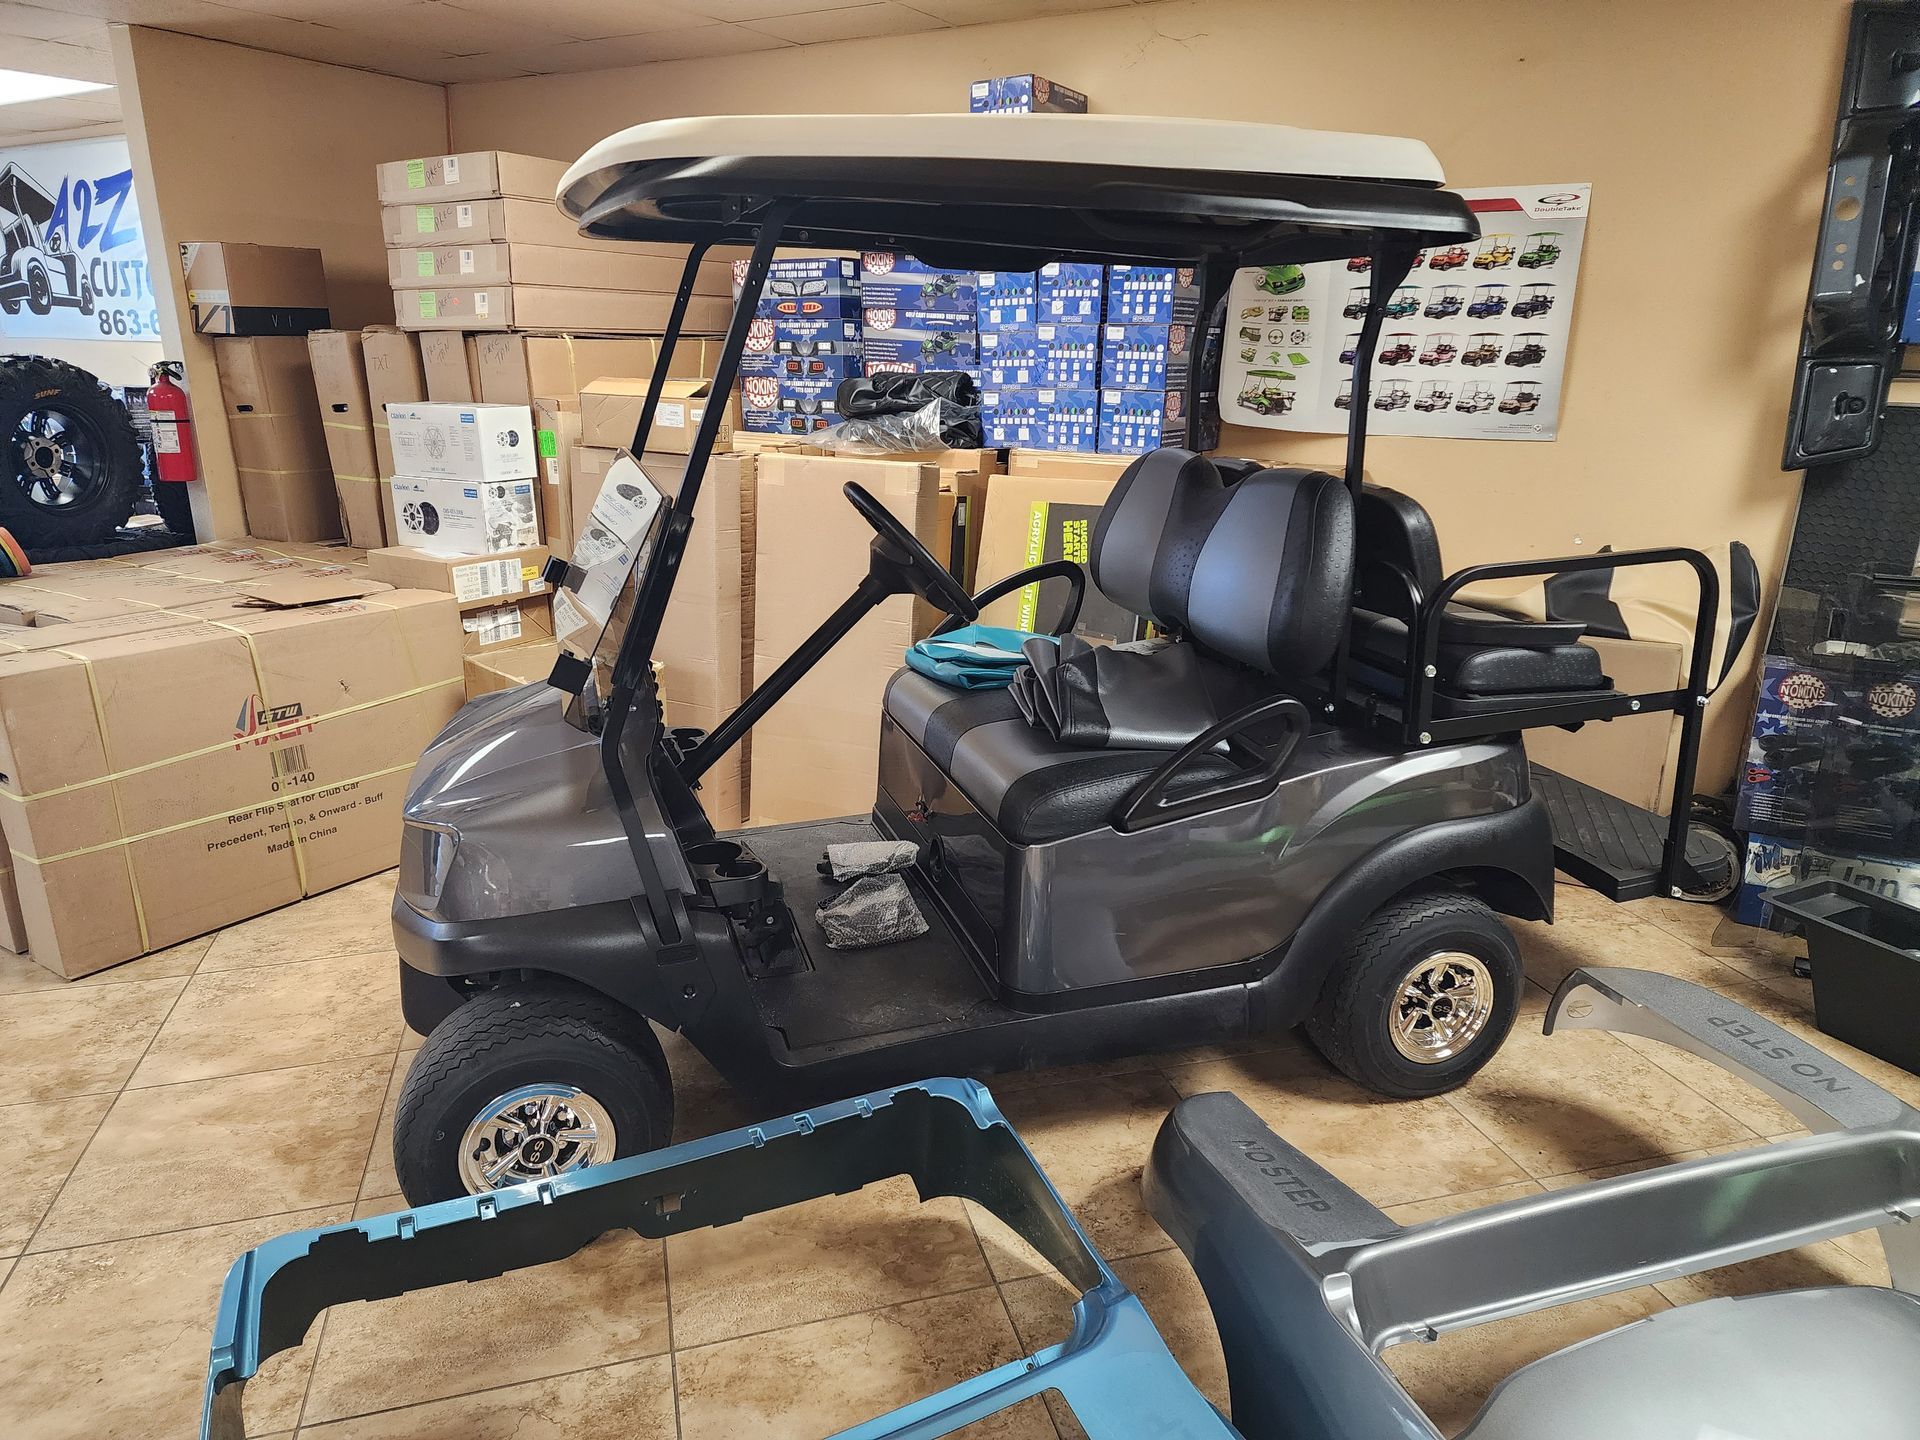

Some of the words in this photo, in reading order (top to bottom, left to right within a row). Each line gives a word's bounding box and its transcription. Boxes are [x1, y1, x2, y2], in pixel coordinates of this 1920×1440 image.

[44, 168, 137, 253] A2Z
[1534, 205, 1582, 213] DoubleTake
[864, 253, 894, 266] NOKINS
[90, 257, 155, 300] CUST
[867, 310, 895, 322] NOKINS
[746, 379, 778, 395] NOKINS
[1028, 510, 1041, 564] ACRYLIC
[1073, 520, 1081, 564] STARTS
[1080, 519, 1088, 564] RUGGED
[1780, 685, 1826, 700] NOKINS
[1869, 692, 1917, 708] NOKINS
[271, 771, 315, 792] 0-140
[228, 810, 254, 825] Rear
[255, 803, 275, 818] Flip
[274, 797, 301, 812] Sat
[301, 793, 316, 804] for
[317, 787, 343, 801] Club
[343, 781, 361, 793] Car
[206, 828, 268, 852] Precedent,
[309, 813, 317, 822] &
[318, 801, 358, 818] Onward
[364, 792, 385, 806] Buff
[266, 839, 296, 855] Made
[309, 825, 338, 842] China
[1434, 1005, 1451, 1014] SS
[1706, 1016, 1796, 1060] STEP
[1791, 1063, 1852, 1093] NO
[530, 1140, 545, 1163] SS
